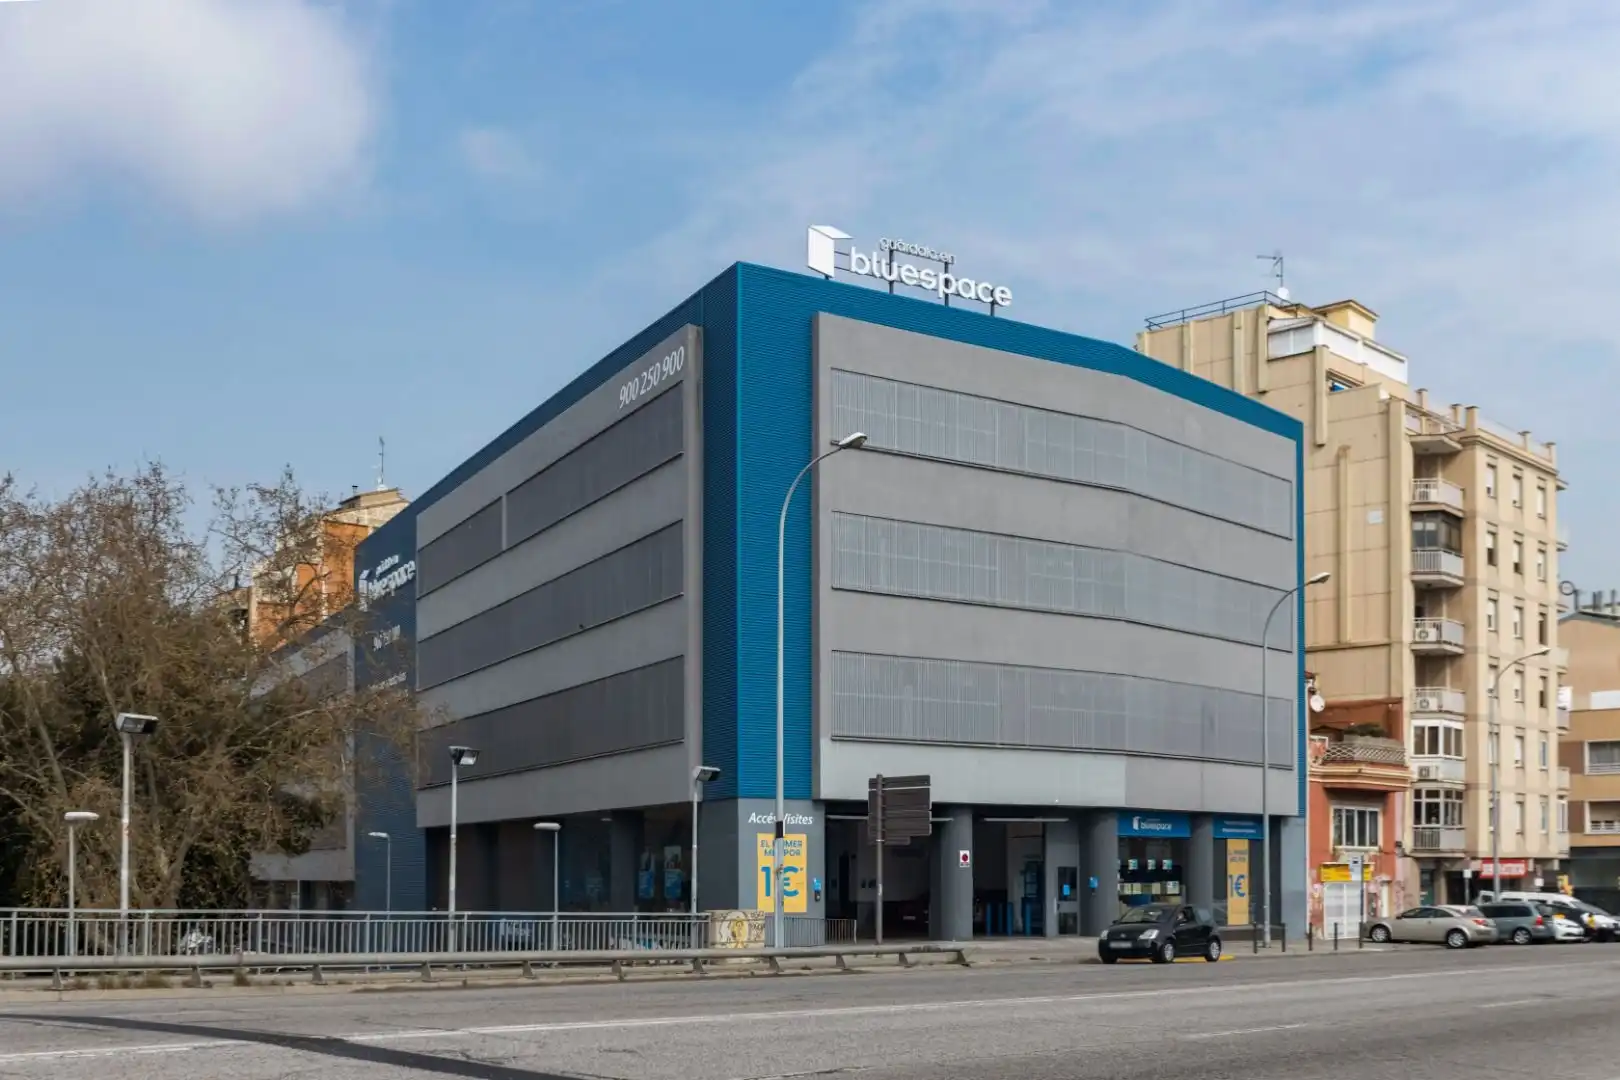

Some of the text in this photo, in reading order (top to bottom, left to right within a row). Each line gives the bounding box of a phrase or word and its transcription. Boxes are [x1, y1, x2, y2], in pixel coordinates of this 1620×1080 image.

[850, 246, 1013, 307] bluespace
[619, 346, 684, 409] 900 250 900
[748, 811, 777, 824] Accé
